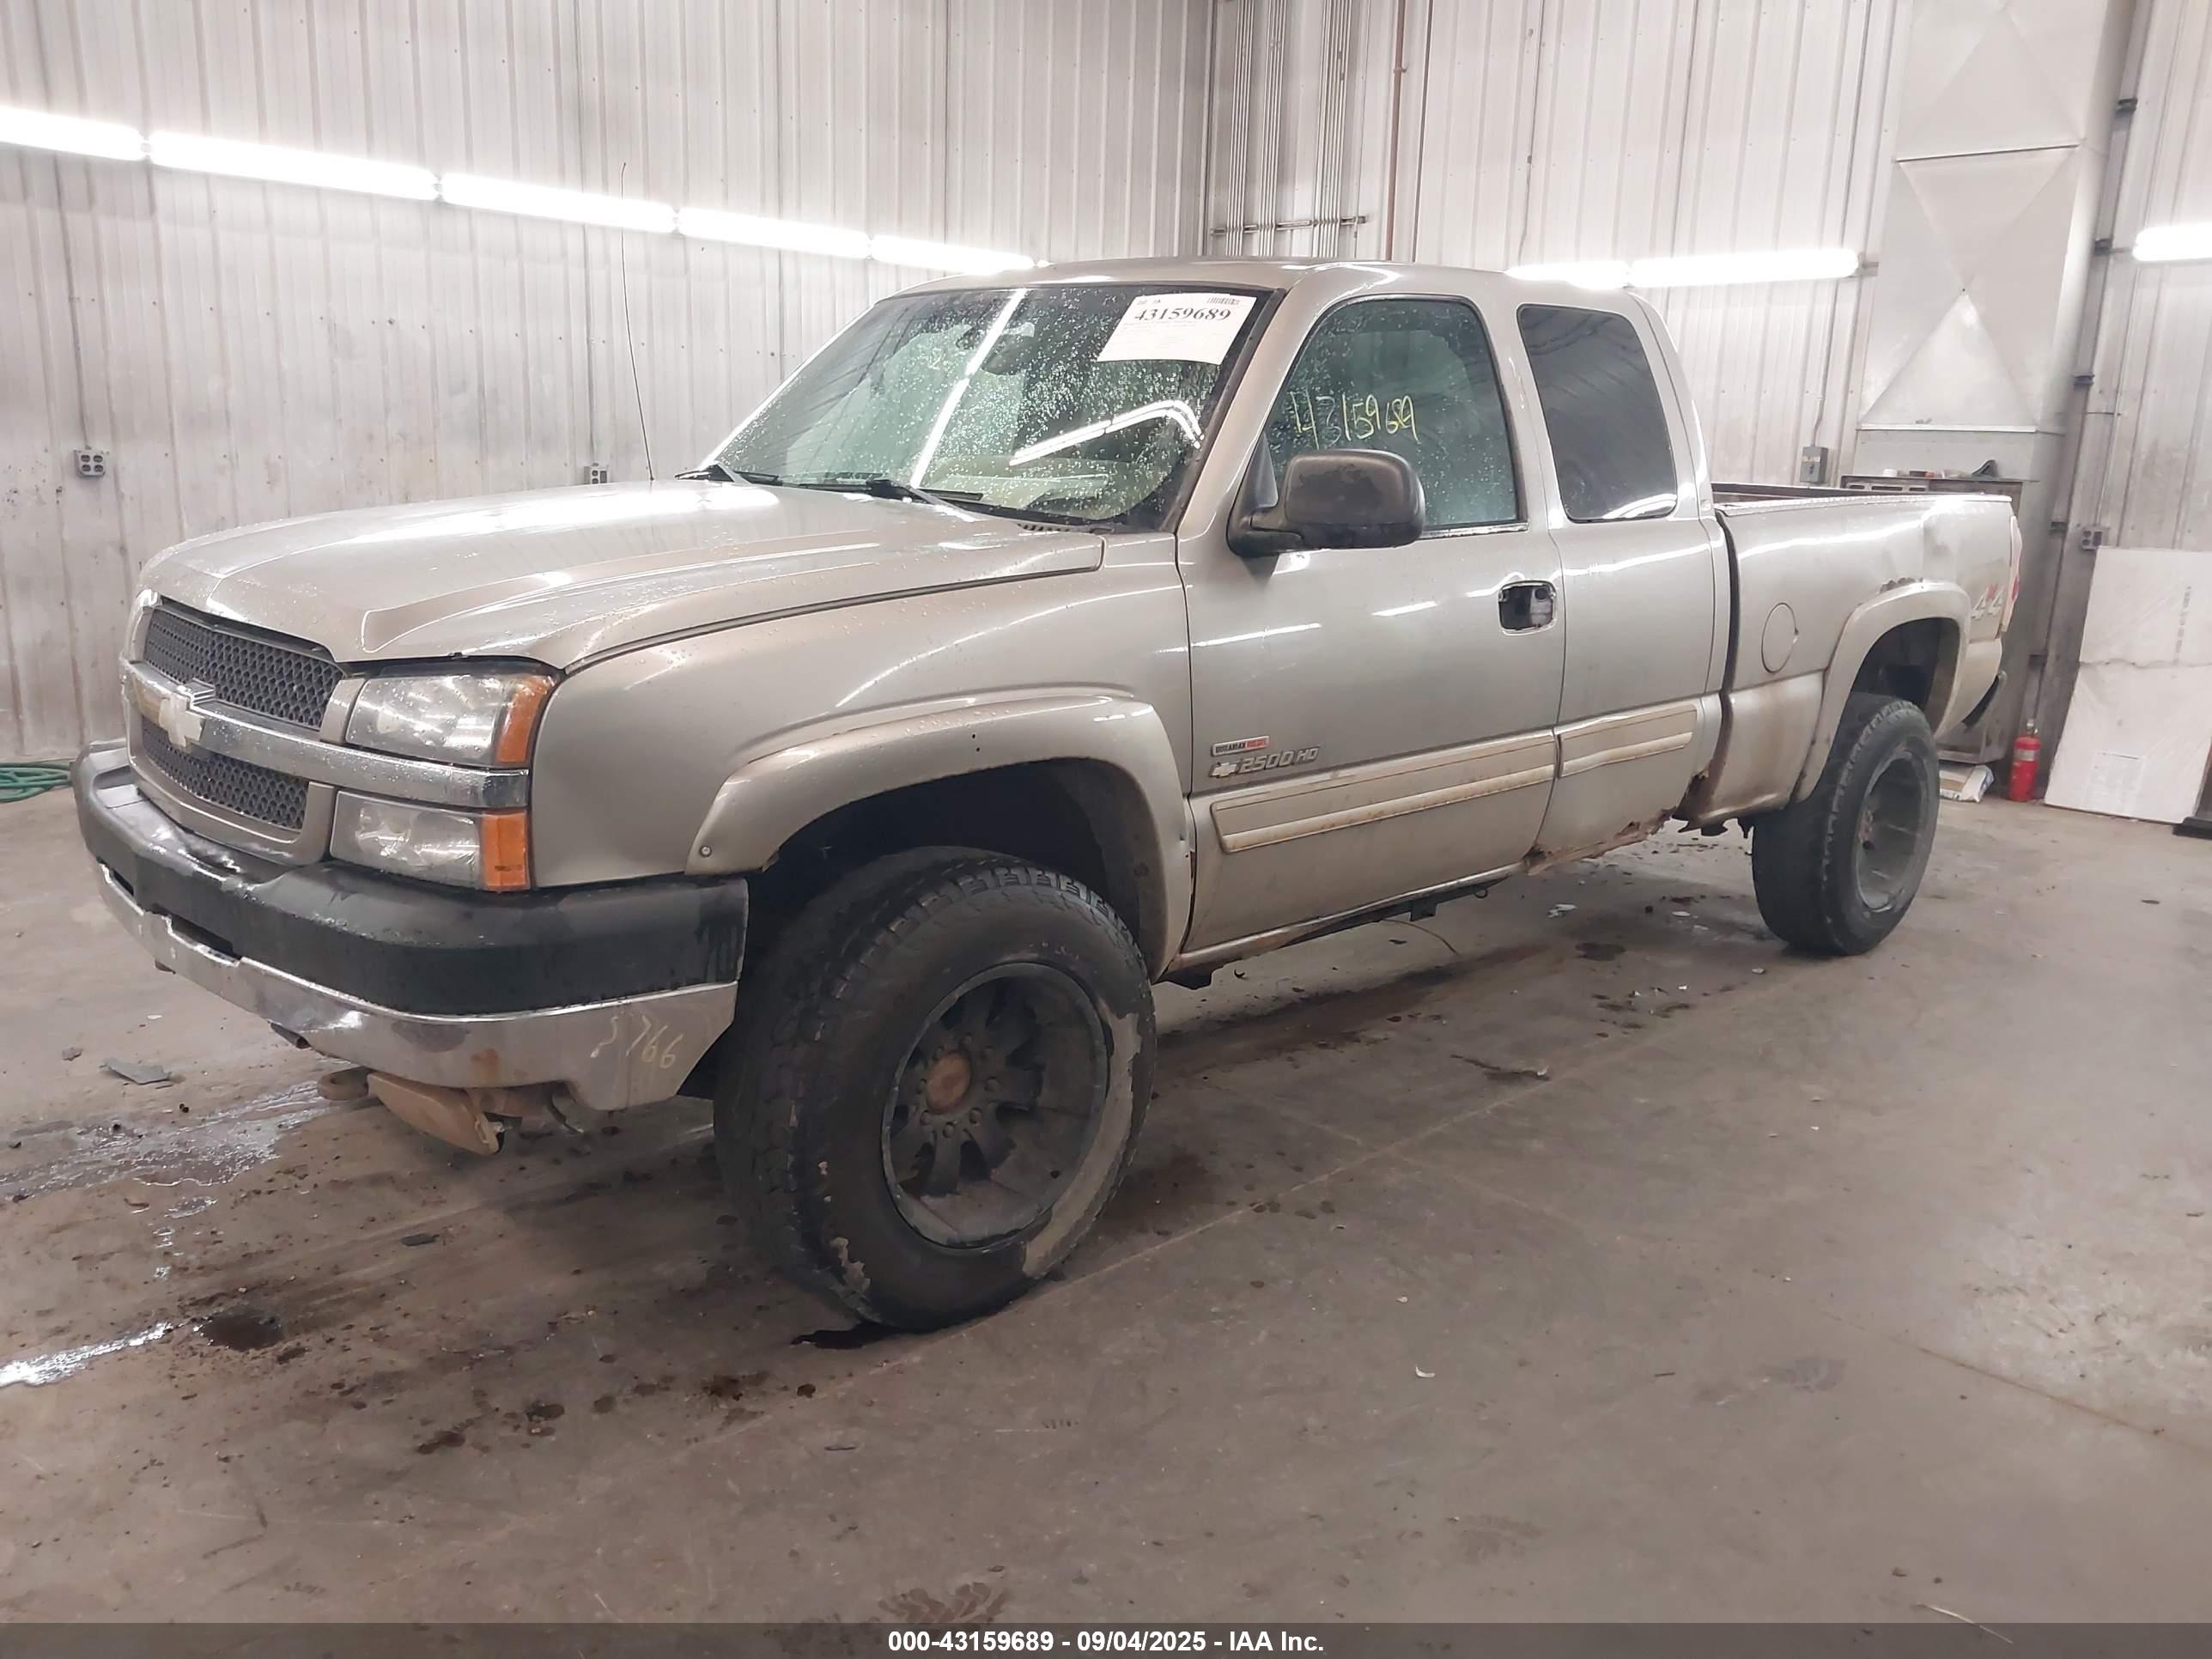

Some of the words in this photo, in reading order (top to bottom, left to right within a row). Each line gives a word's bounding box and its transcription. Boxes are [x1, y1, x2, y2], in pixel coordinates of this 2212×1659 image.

[1134, 307, 1231, 322] 43159689
[1238, 750, 1294, 774] 2500
[1296, 746, 1320, 763] HD
